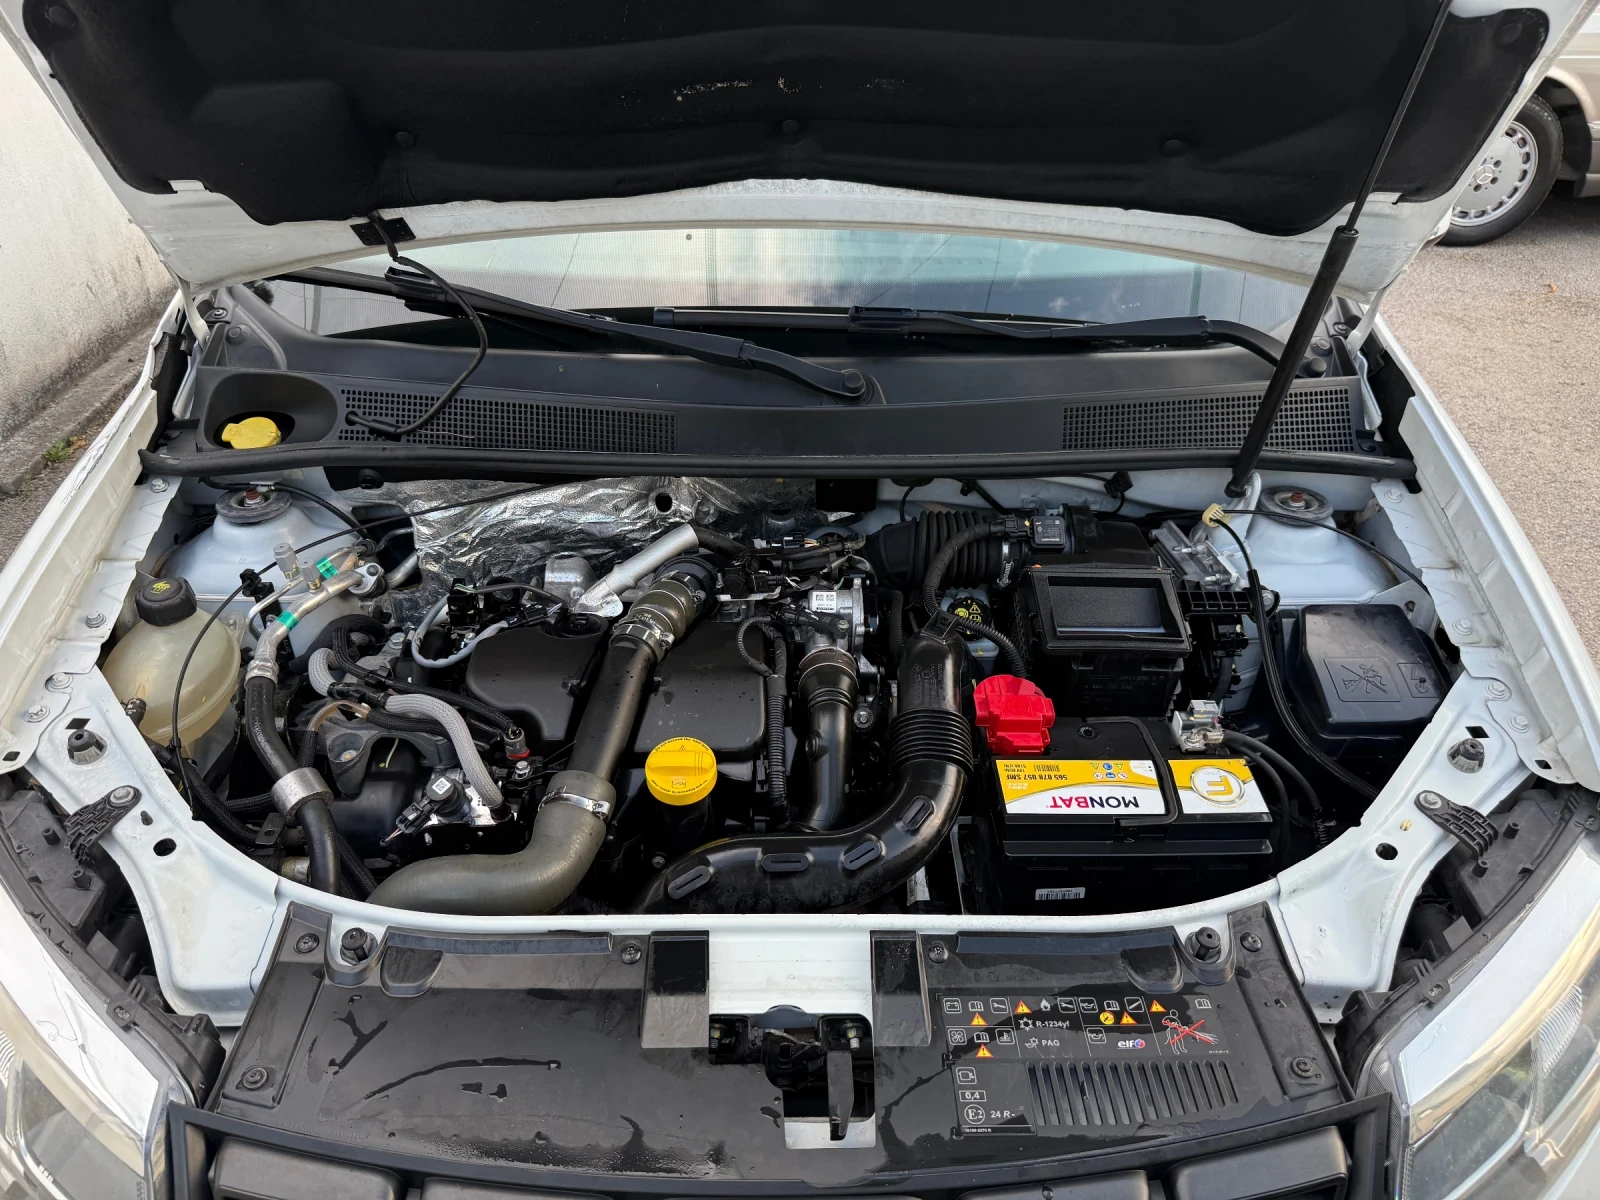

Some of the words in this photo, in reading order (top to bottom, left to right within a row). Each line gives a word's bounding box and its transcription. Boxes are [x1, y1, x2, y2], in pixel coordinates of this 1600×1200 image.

[1206, 775, 1234, 797] F
[1049, 795, 1140, 809] MONBAT
[1041, 1039, 1060, 1047] PAG
[1117, 1039, 1136, 1048] elf
[965, 1092, 980, 1100] 0,4
[967, 1108, 984, 1120] E2
